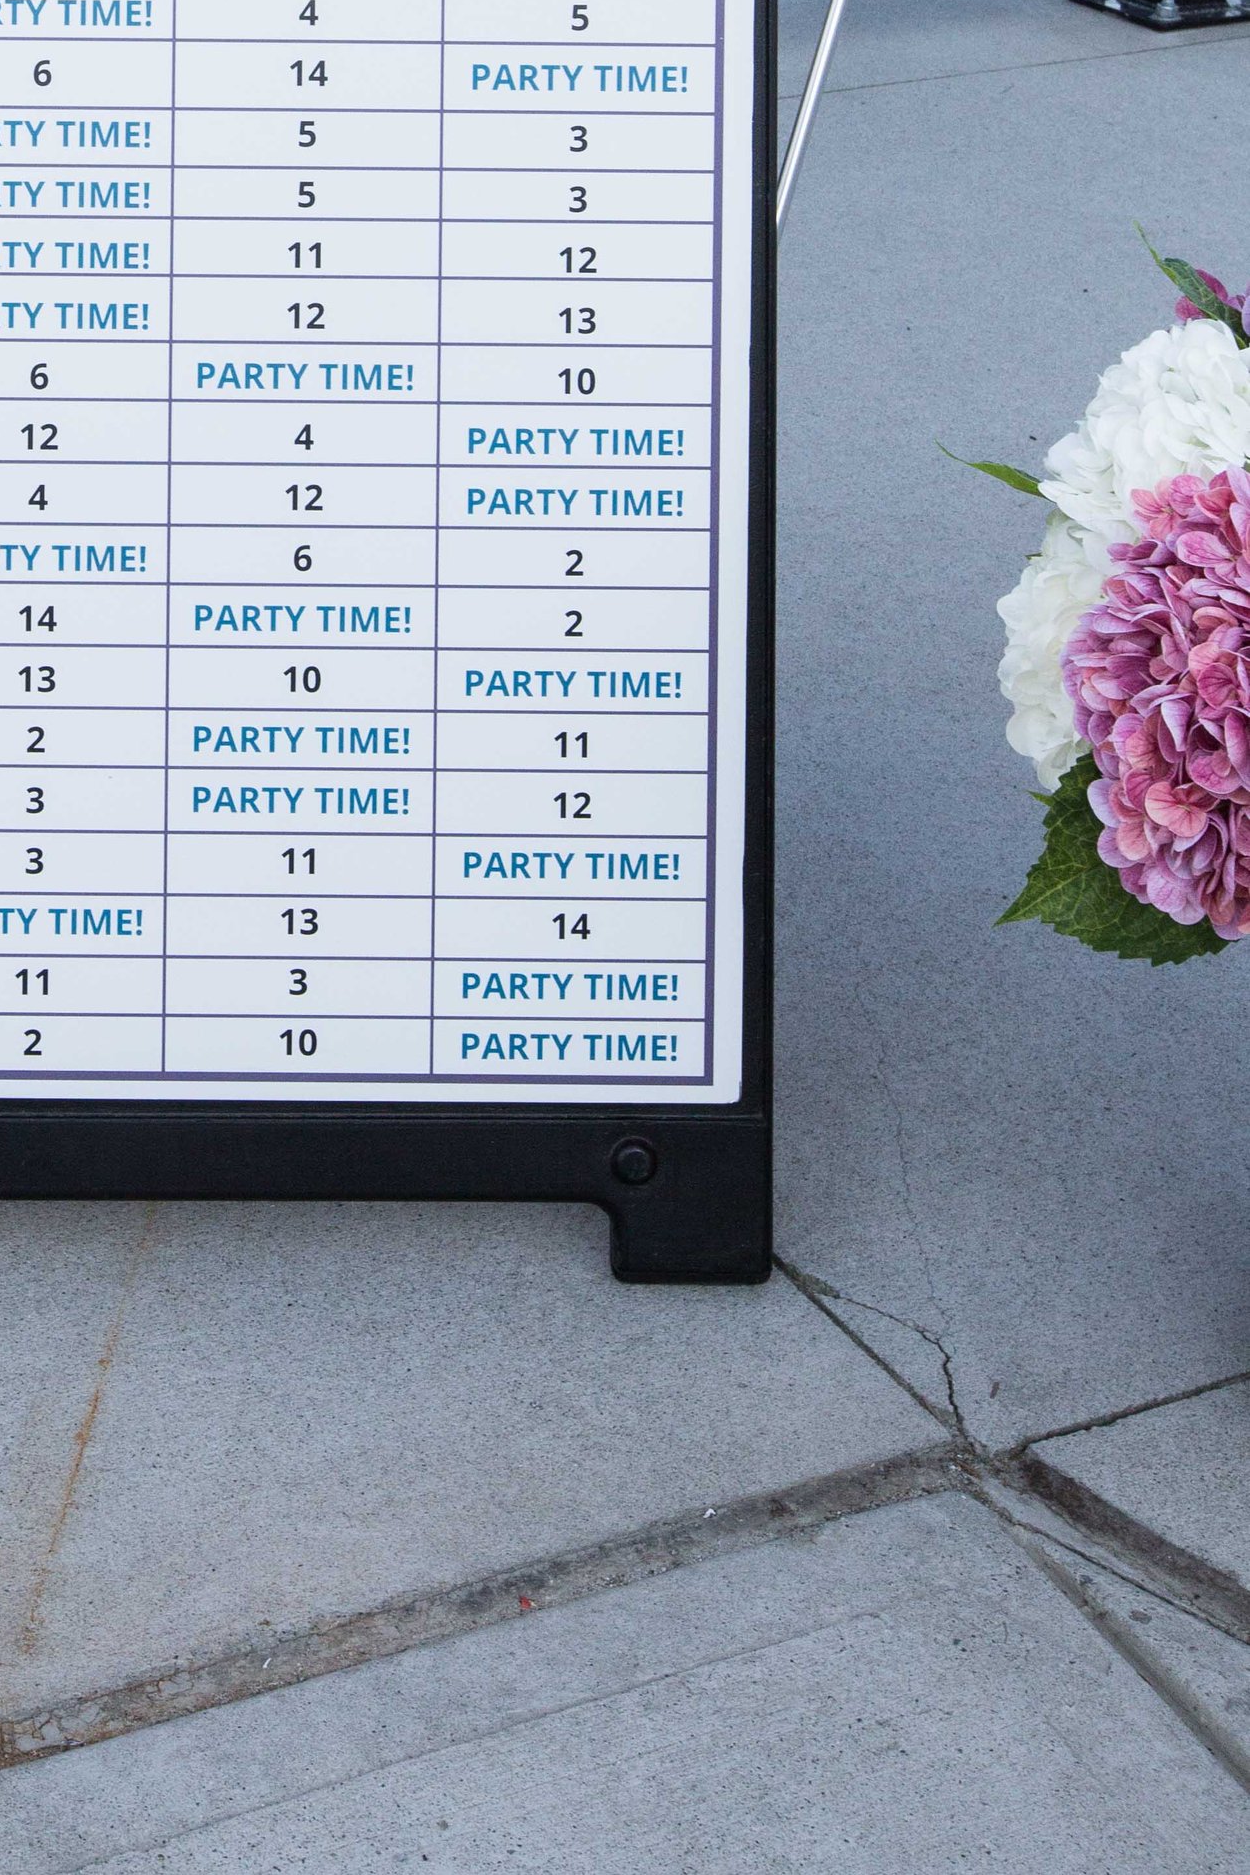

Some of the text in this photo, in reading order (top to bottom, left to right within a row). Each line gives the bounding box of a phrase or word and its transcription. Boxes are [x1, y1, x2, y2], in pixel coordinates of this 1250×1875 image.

[55, 120, 151, 149] TIME!
[298, 120, 317, 148] 5
[569, 125, 588, 153] 3
[30, 362, 49, 391] 6
[196, 362, 414, 392] PARTY TIME!
[557, 367, 596, 396] 10
[18, 605, 58, 633] 14
[194, 604, 411, 634] PARTY TIME!
[564, 609, 584, 637] 2
[25, 786, 45, 815] 3
[192, 786, 410, 816] PARTY TIME!
[553, 791, 592, 819] 12
[23, 1028, 43, 1056] 2
[279, 1028, 318, 1057] 10
[461, 1032, 677, 1061] PARTY TIME!
